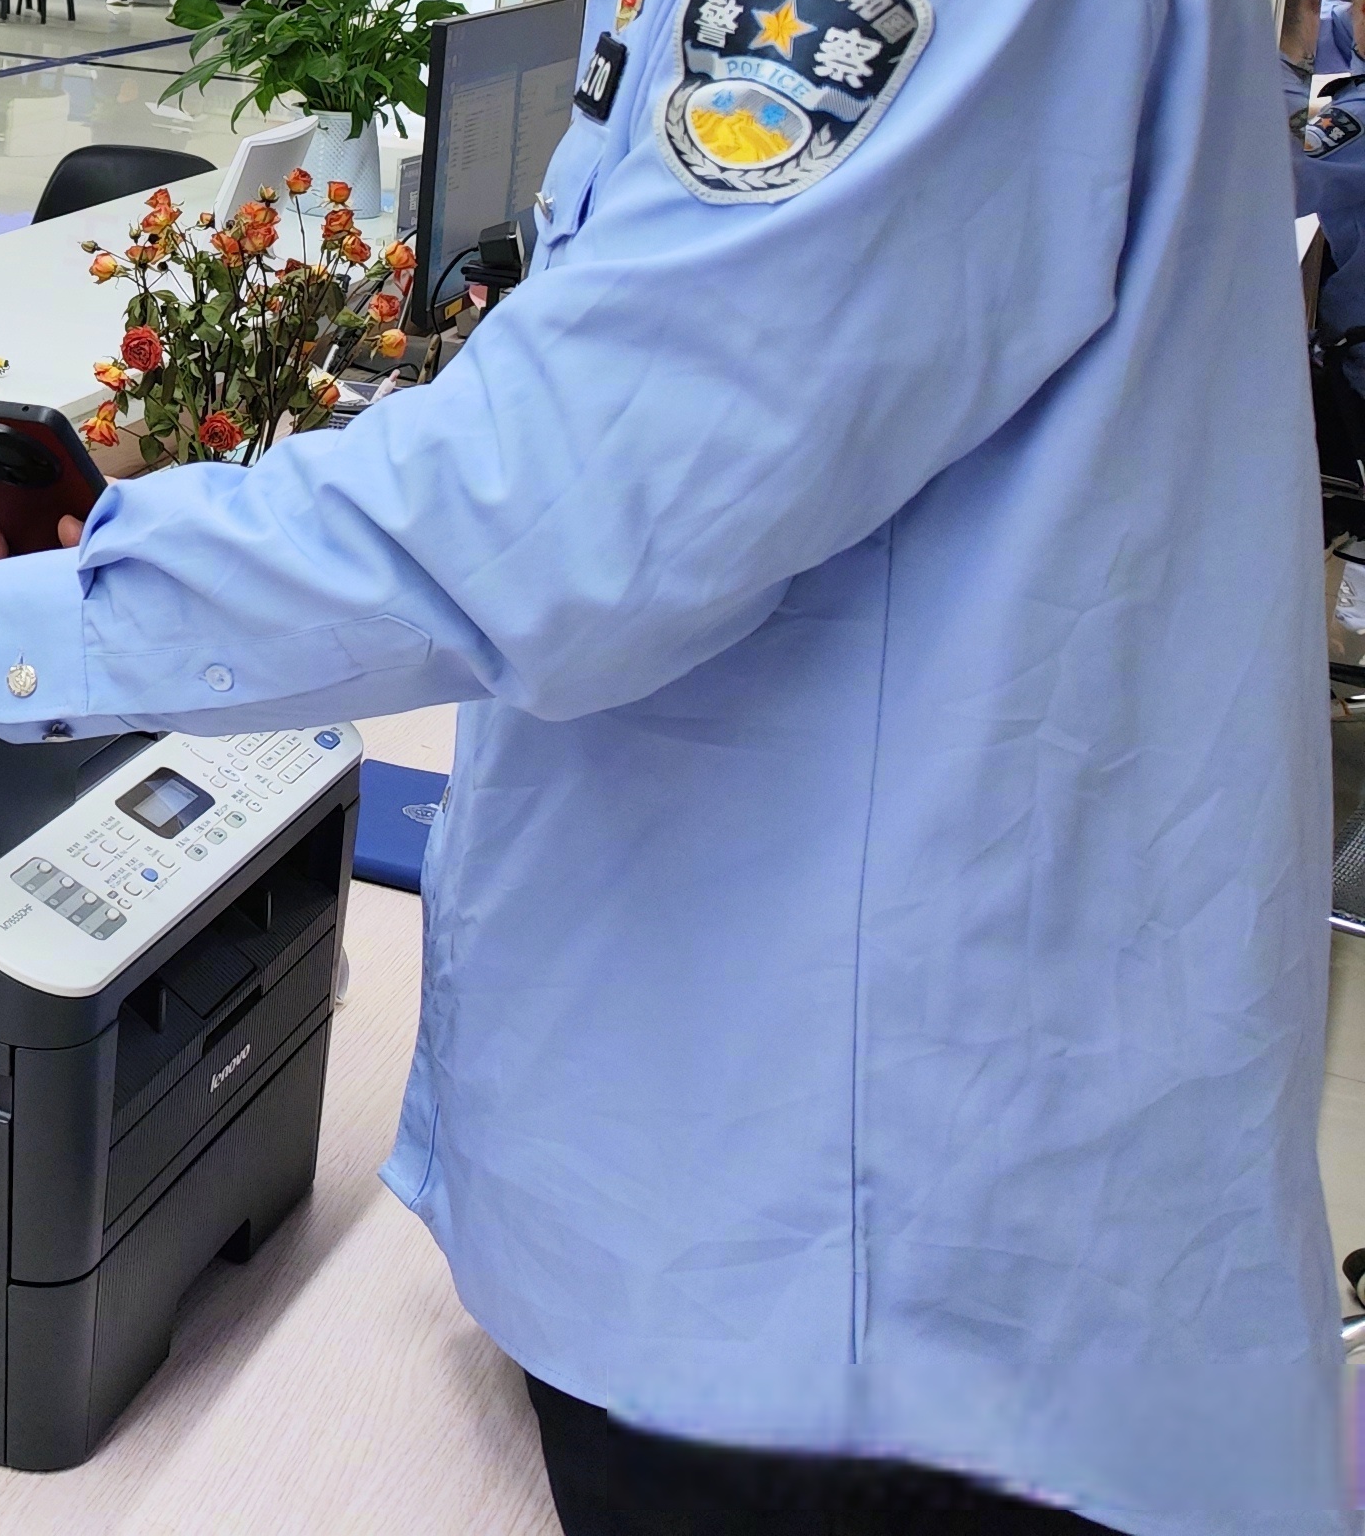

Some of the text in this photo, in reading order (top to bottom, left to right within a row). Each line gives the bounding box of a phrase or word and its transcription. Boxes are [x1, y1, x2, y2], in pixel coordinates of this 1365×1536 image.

[725, 59, 813, 99] POLICE
[812, 26, 883, 89] 察
[209, 1043, 251, 1094] lenovo
